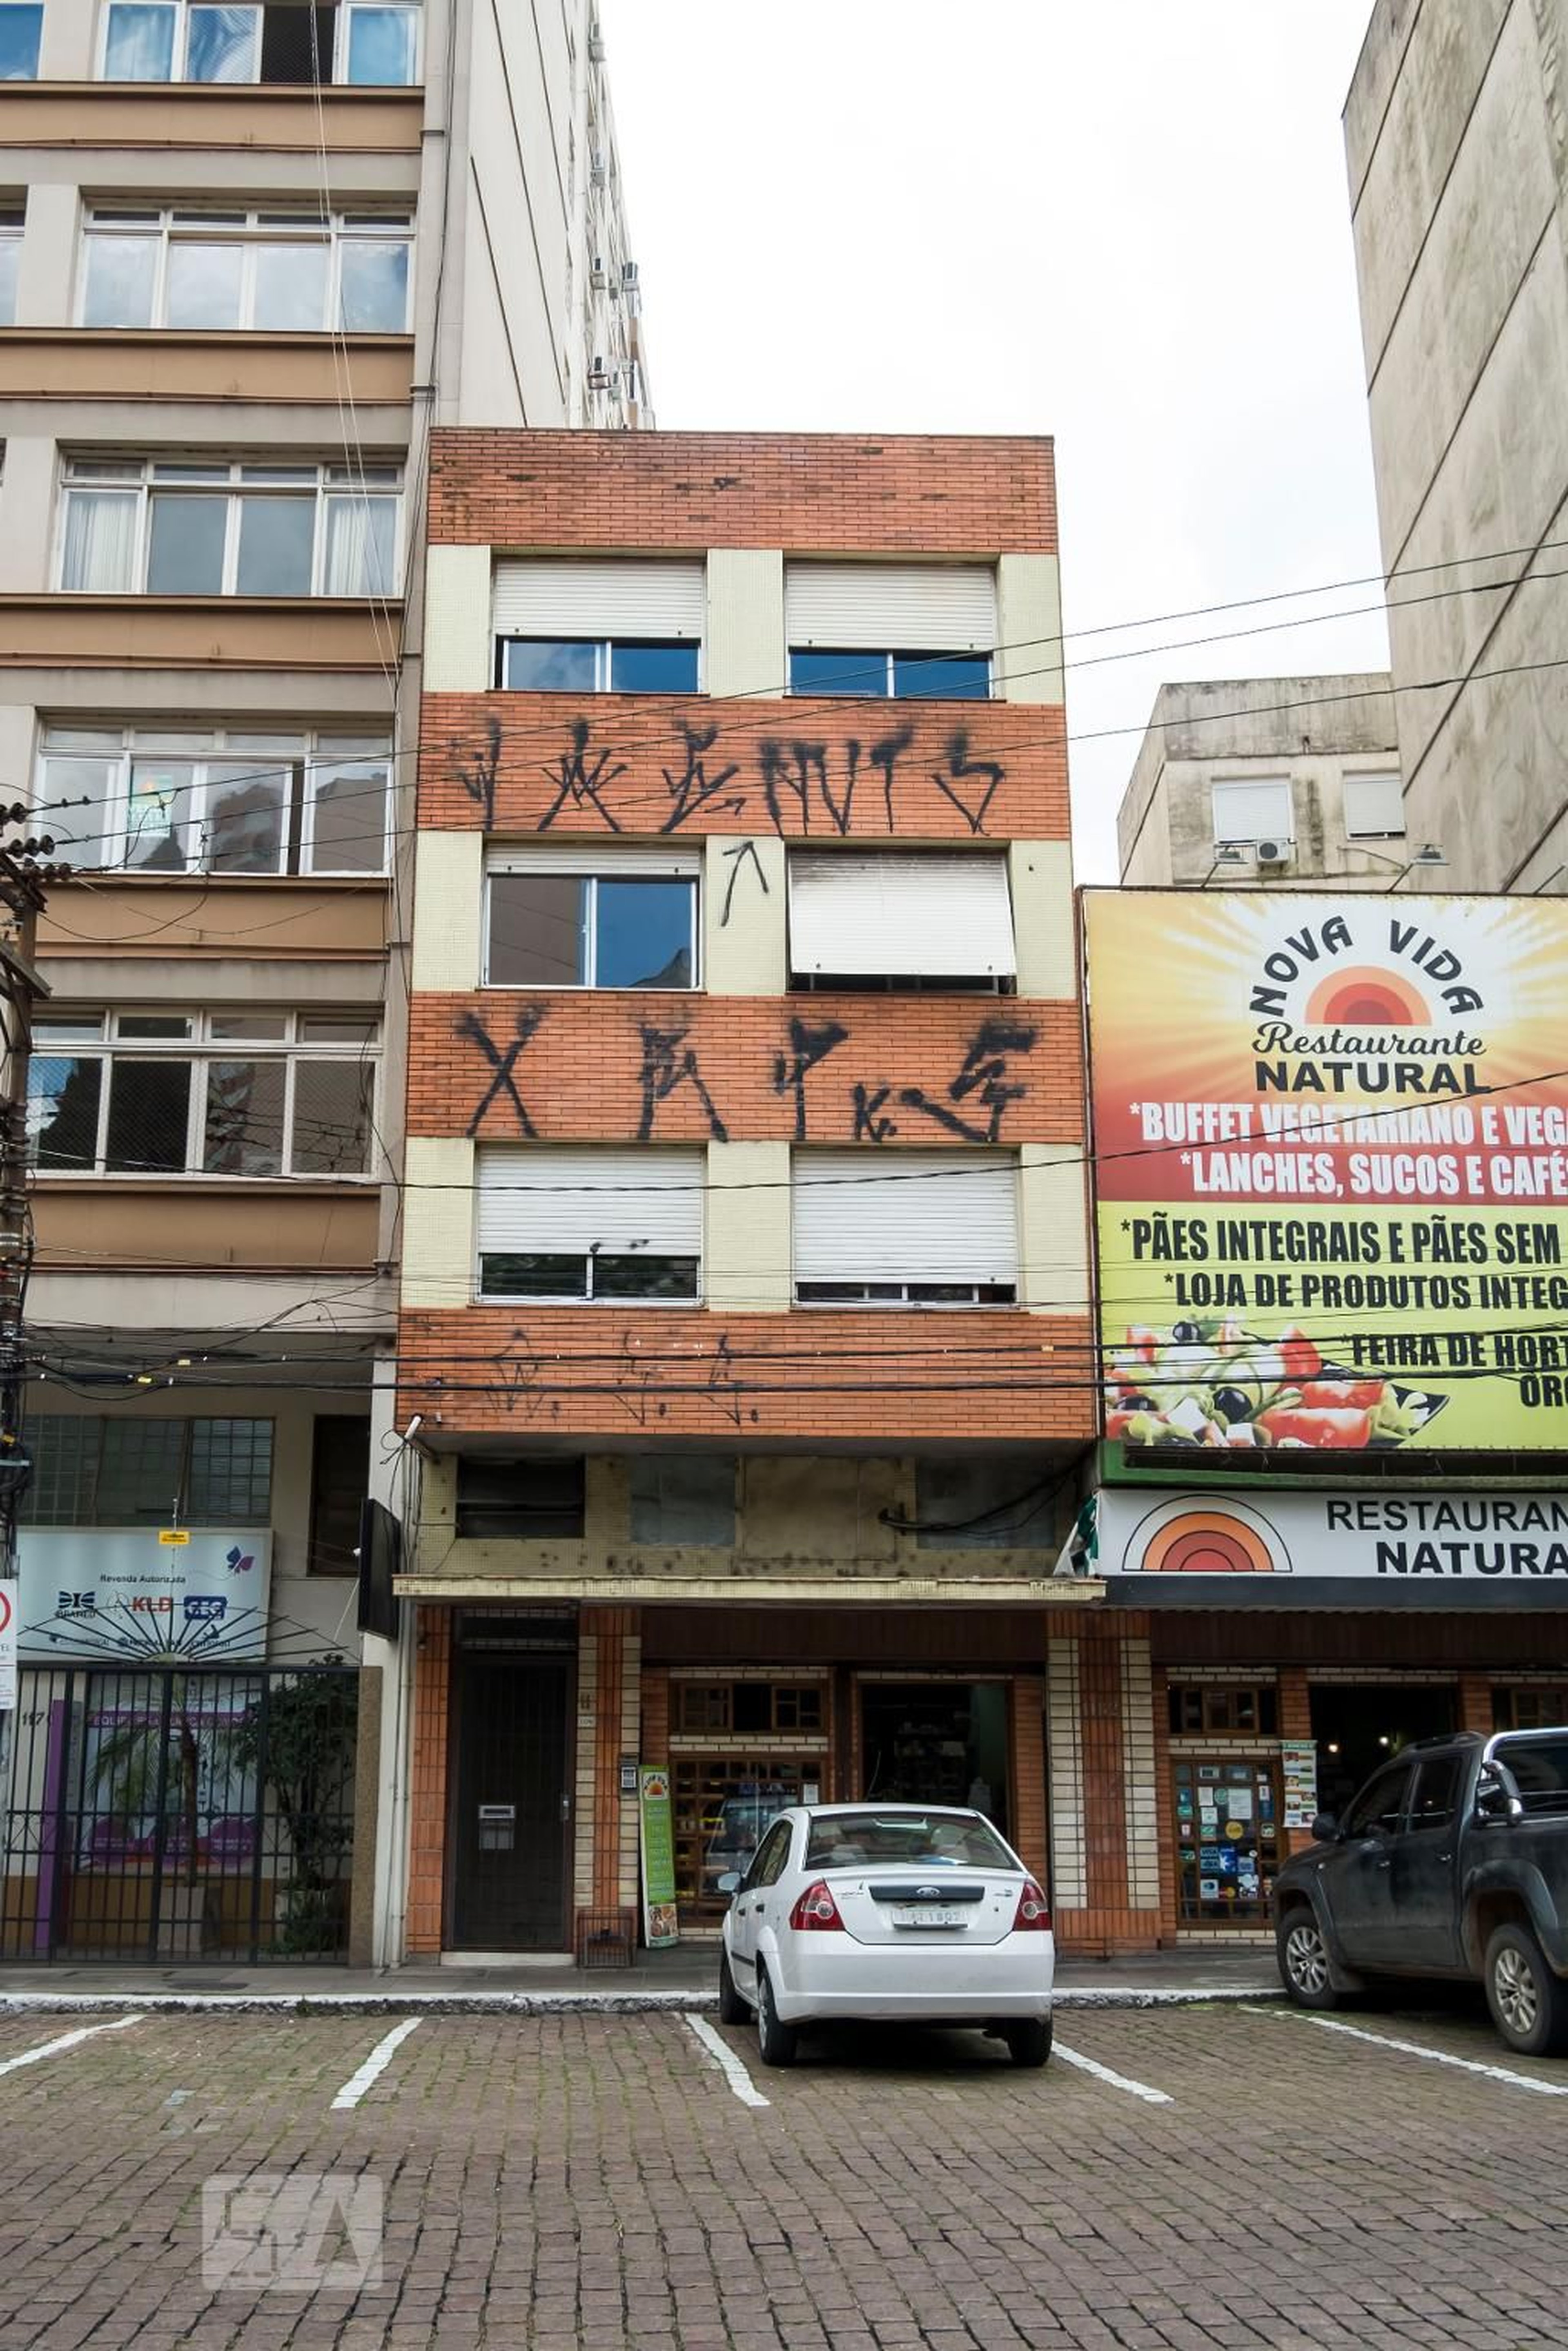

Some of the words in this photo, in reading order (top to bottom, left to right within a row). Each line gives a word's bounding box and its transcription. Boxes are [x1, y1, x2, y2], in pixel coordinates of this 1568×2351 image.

[1249, 915, 1354, 1017] NOVA
[1389, 920, 1484, 1015] VIDA
[1252, 1021, 1486, 1057] Restaurante
[1255, 1061, 1491, 1094] NATURAL
[1261, 1104, 1474, 1145] VEGETARIANO
[1481, 1106, 1500, 1144] E
[1503, 1105, 1568, 1145] VEG
[1350, 1155, 1460, 1195] SUCOS
[1466, 1155, 1484, 1194] E
[1490, 1150, 1568, 1195] CAFÉ
[1218, 1219, 1381, 1262] INTEGRAIS
[1390, 1222, 1404, 1262] E
[1413, 1214, 1488, 1263] PÃES
[1495, 1222, 1561, 1264] SEM
[1256, 1274, 1292, 1307] DE
[1301, 1275, 1471, 1309] PRODUTOS
[1479, 1275, 1568, 1309] INTEG
[1447, 1334, 1487, 1366] DE
